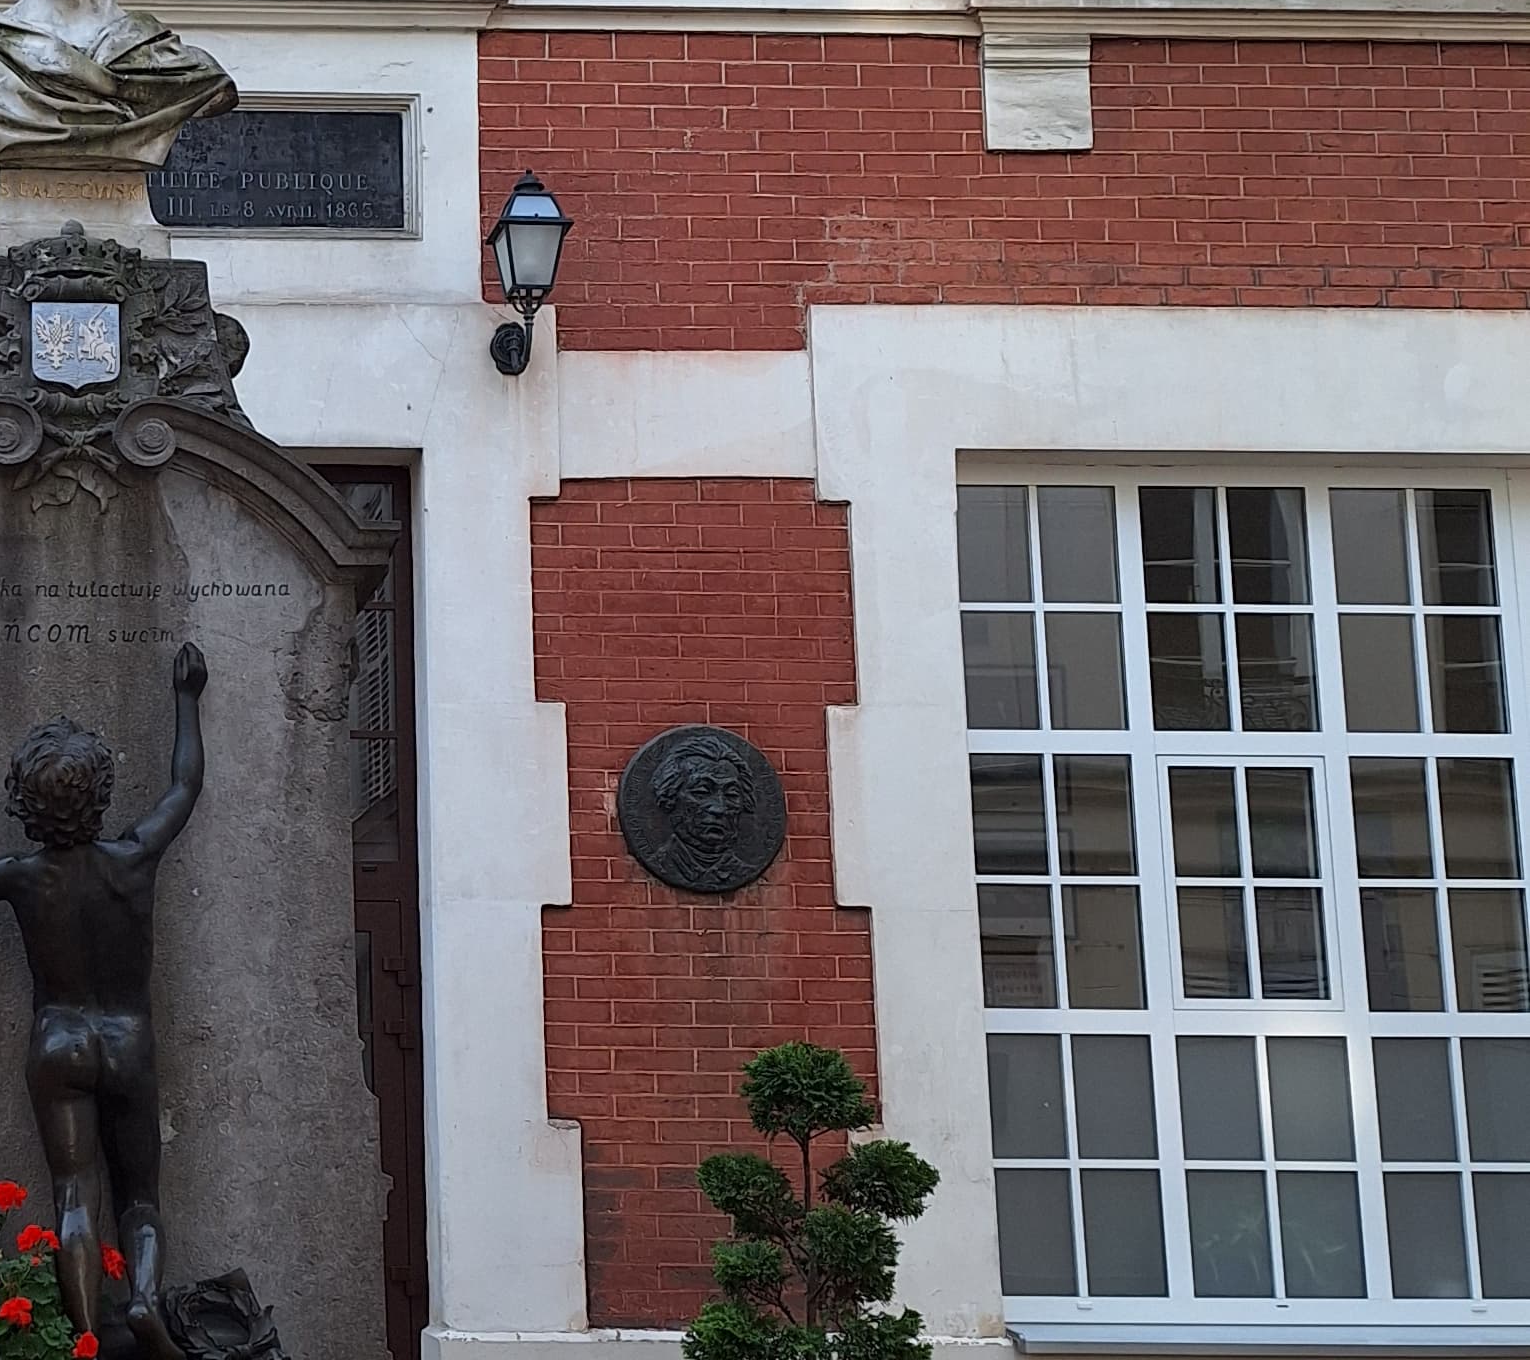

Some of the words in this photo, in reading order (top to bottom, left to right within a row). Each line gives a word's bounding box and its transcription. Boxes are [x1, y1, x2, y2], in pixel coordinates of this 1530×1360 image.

[243, 201, 255, 218] 8
[35, 583, 61, 598] na
[173, 582, 291, 603] wychowana
